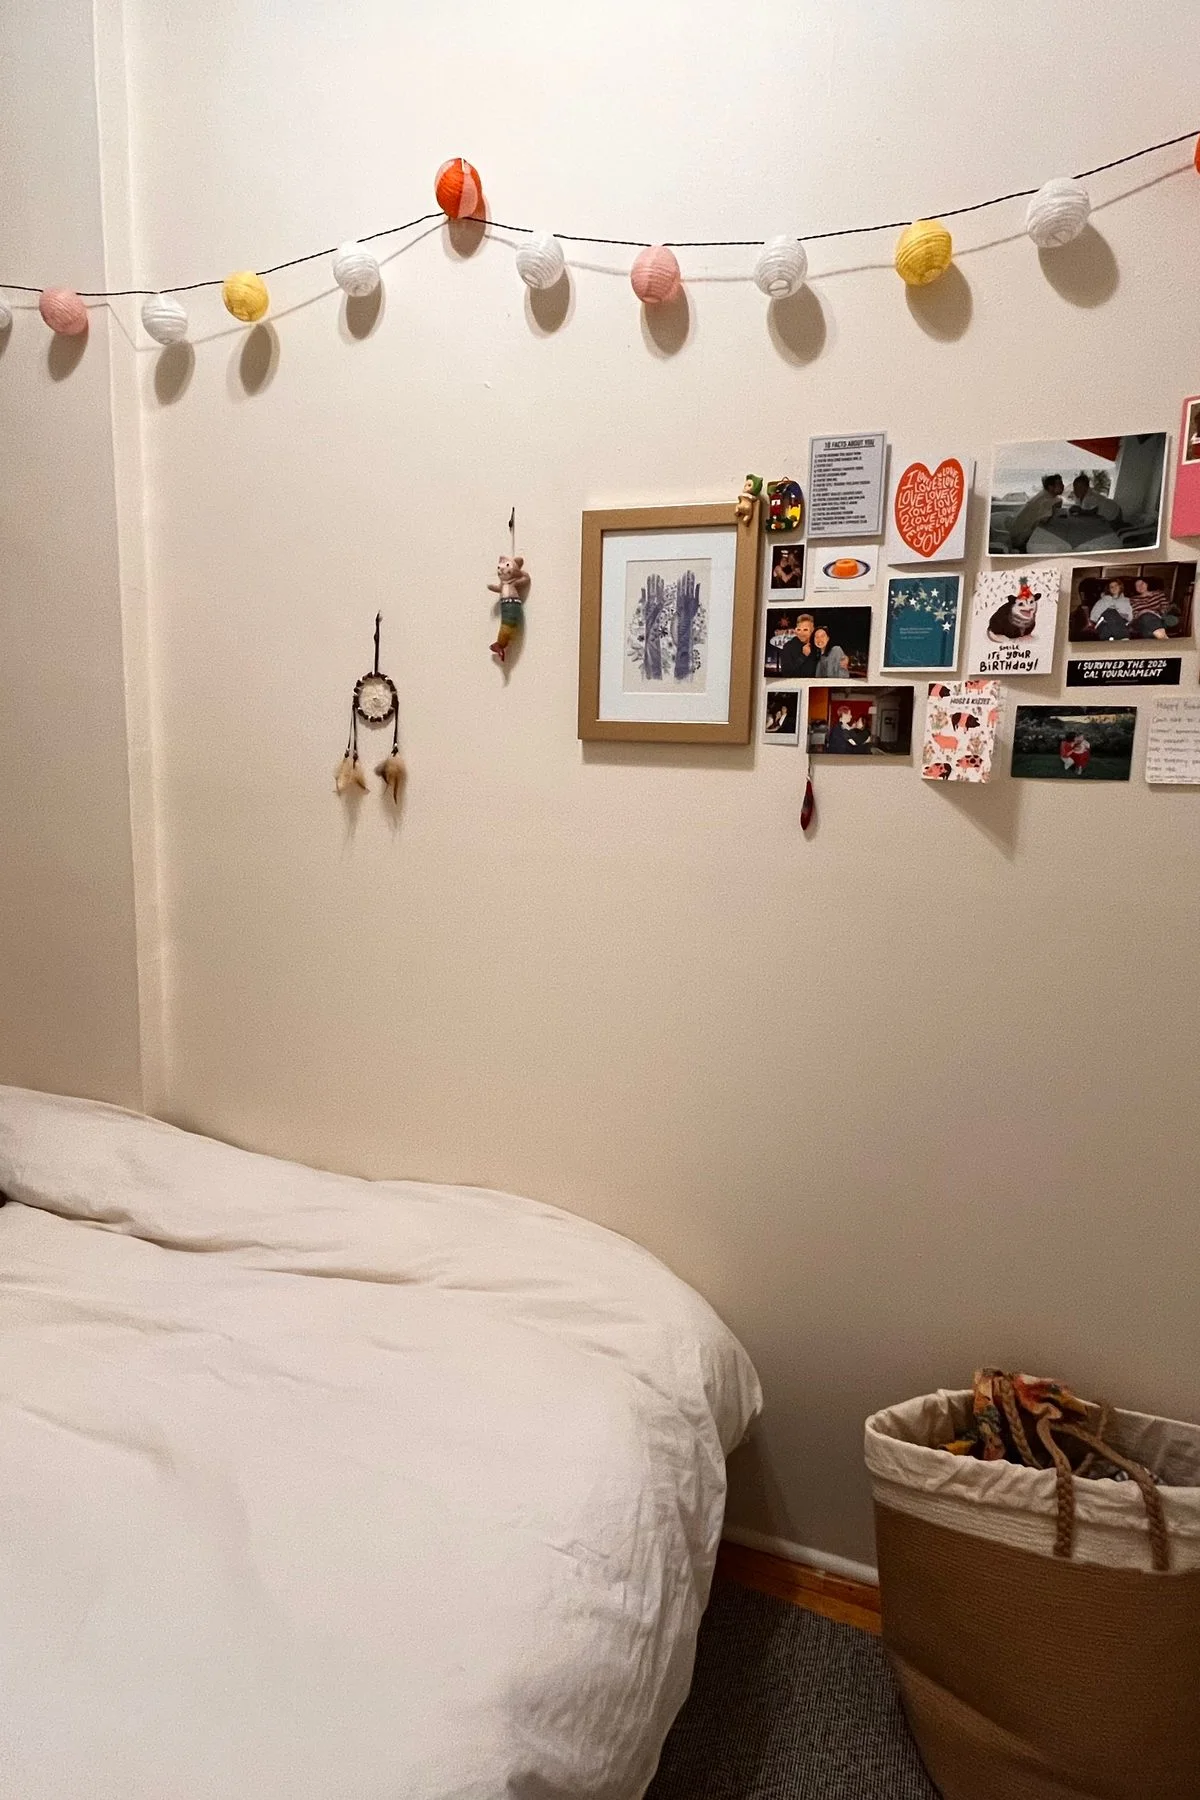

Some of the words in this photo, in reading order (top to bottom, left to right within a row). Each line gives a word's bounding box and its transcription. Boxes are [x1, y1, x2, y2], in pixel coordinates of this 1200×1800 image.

[832, 440, 847, 448] FACTS
[848, 439, 864, 447] ABOUT
[865, 438, 875, 447] YOU
[898, 489, 925, 509] LOVE
[1083, 661, 1125, 670] SURVIVED
[1127, 660, 1145, 669] THE
[1101, 668, 1163, 678] TOURNAMENT
